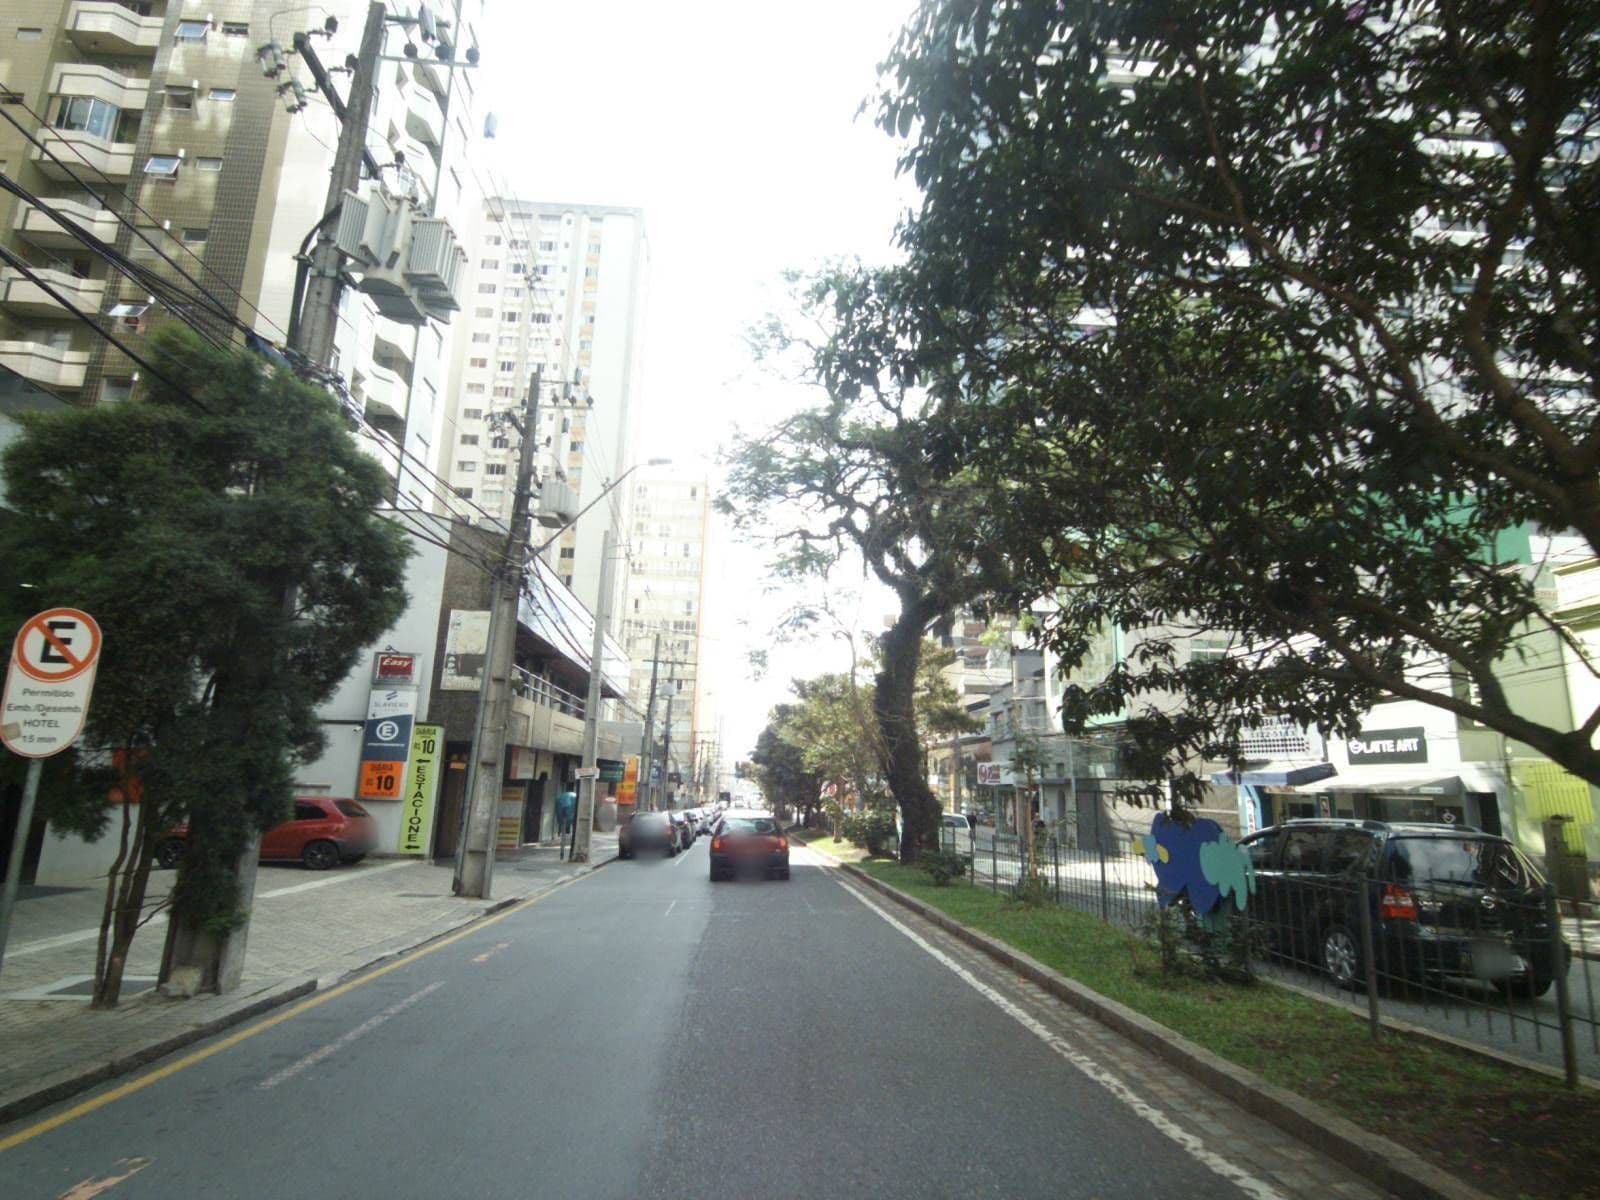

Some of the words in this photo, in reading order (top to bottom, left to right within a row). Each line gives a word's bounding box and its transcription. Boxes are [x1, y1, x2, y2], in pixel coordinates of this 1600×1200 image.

[40, 621, 76, 664] E
[382, 658, 411, 667] Easy
[22, 688, 75, 698] Permitido
[23, 719, 61, 729] HOTEL
[382, 725, 393, 738] E
[22, 735, 35, 743] 15
[1396, 738, 1420, 752] ART
[422, 739, 435, 754] 10
[377, 775, 394, 791] 10
[407, 765, 426, 842] ESTACIONE
